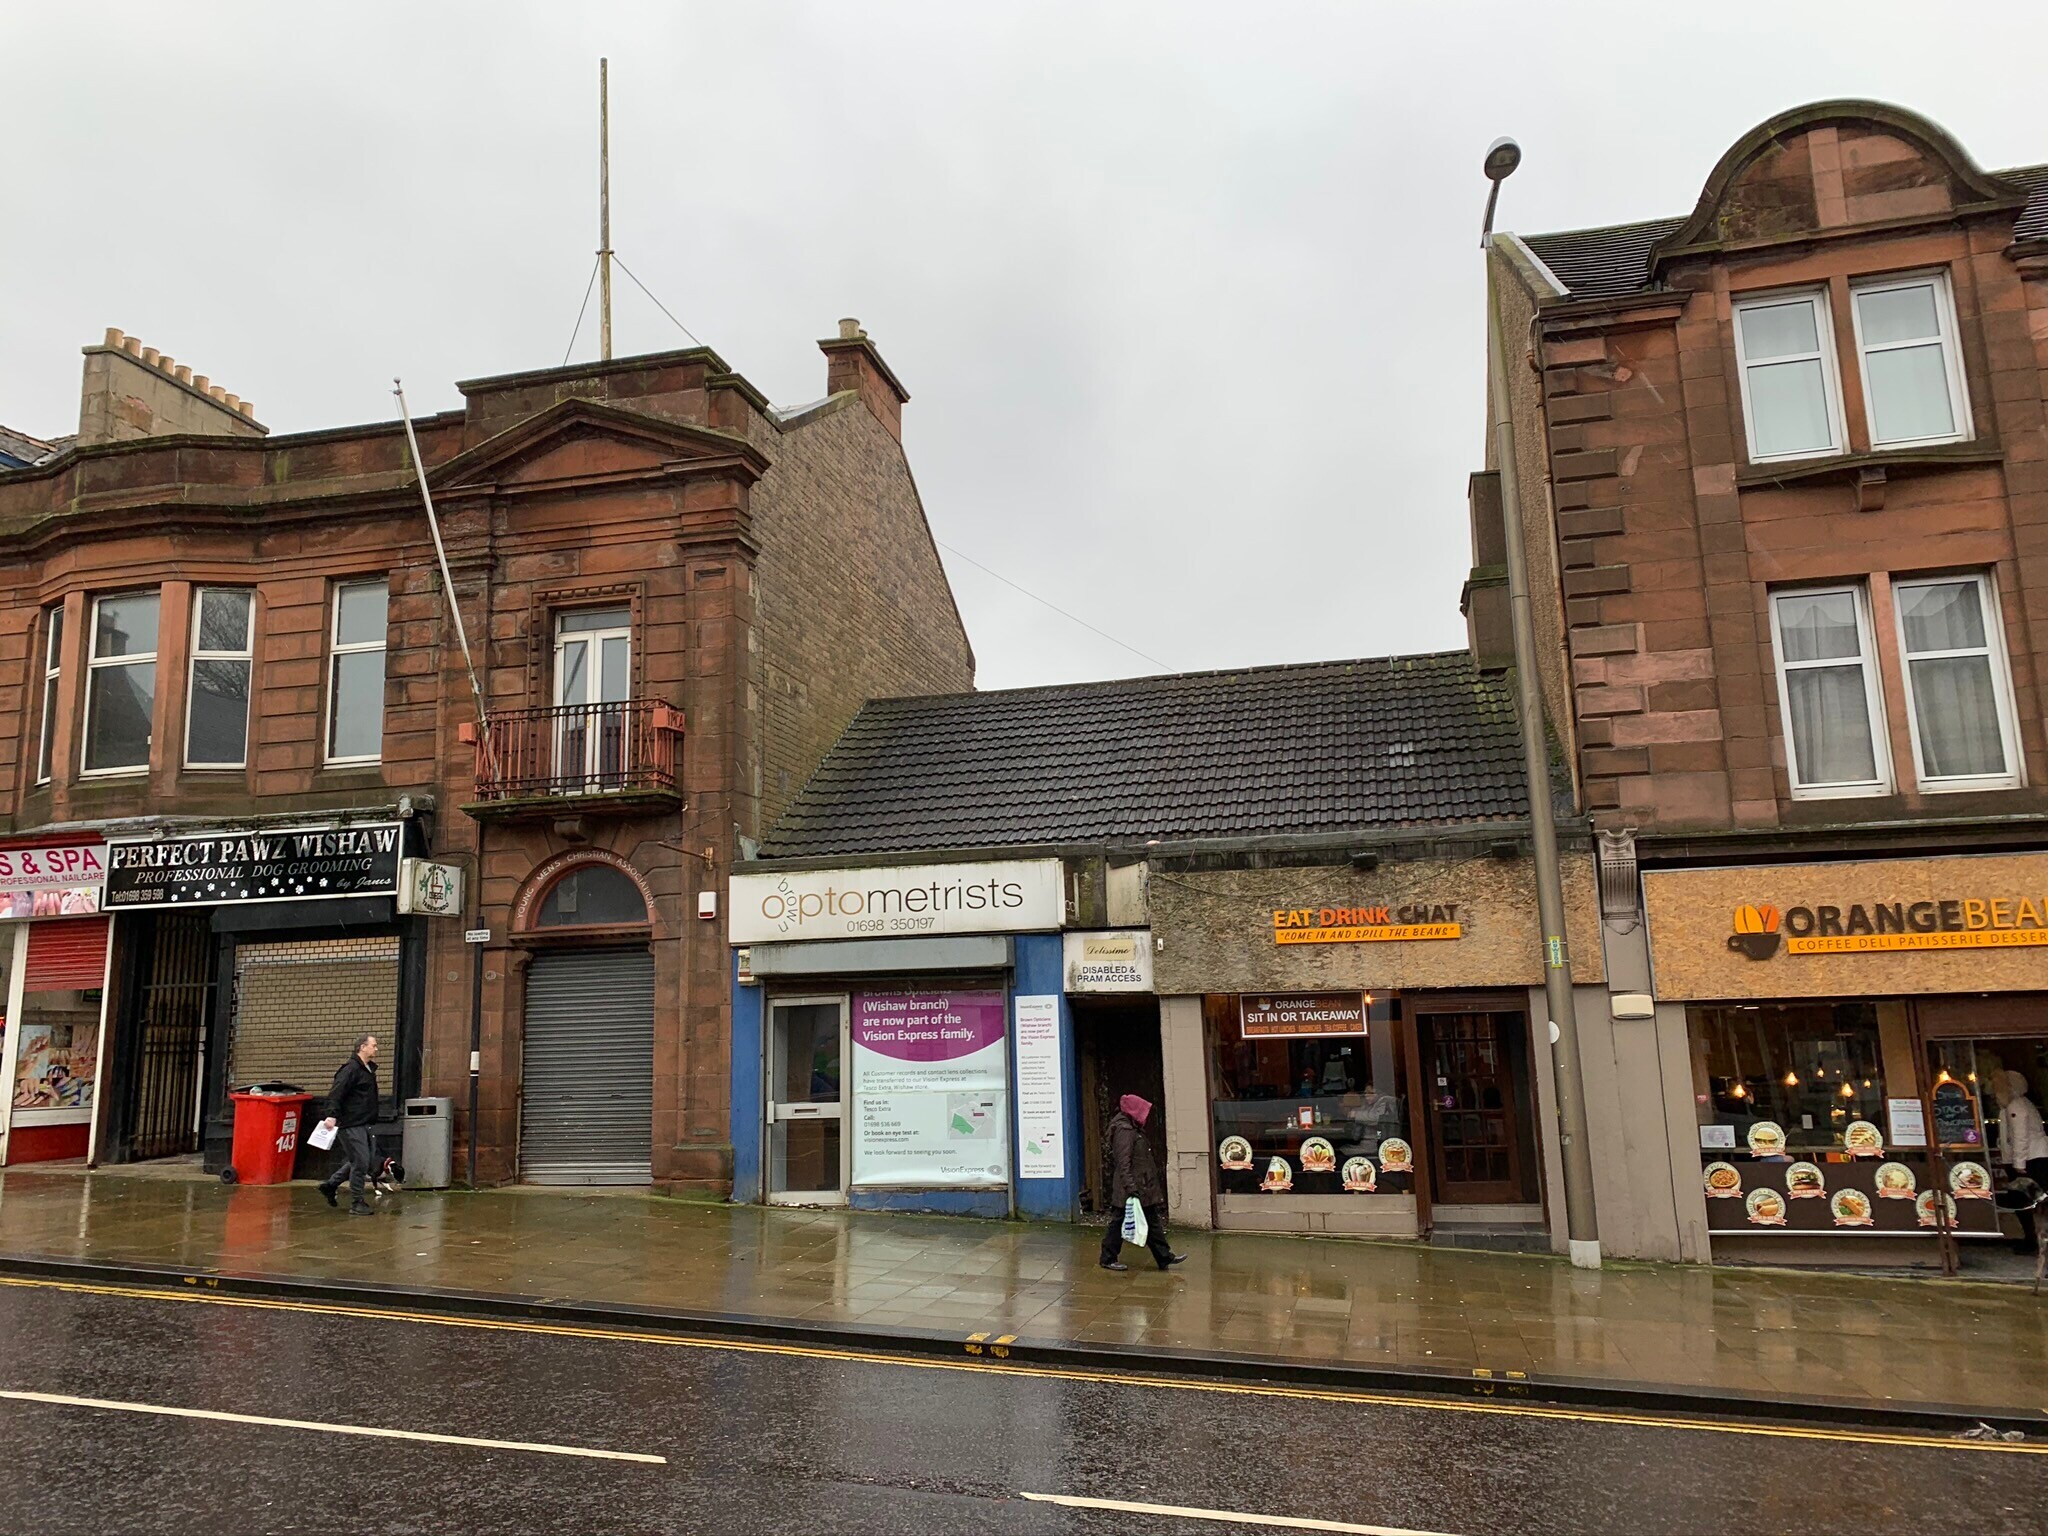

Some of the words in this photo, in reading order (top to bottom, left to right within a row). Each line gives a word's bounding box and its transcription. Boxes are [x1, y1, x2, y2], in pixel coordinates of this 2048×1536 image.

[110, 841, 215, 869] PERFECT
[219, 837, 287, 863] PAWZ
[293, 829, 397, 858] WISHAW
[21, 852, 41, 875] &
[46, 848, 103, 873] SPA
[134, 866, 245, 884] PROFESSIONAL
[250, 863, 284, 877] DOG
[288, 857, 372, 875] GROOMING
[0, 876, 60, 886] ROFESSIONAL
[62, 871, 105, 882] NAILCARE
[517, 887, 534, 919] YOUNG
[566, 851, 612, 862] CHRISTIAN
[616, 858, 655, 909] ASSOCIATION
[762, 878, 1024, 925] optometrists
[777, 877, 799, 933] brown
[846, 919, 885, 932] 01698
[890, 917, 936, 931] 350197
[1273, 909, 1313, 928] EAT
[1319, 906, 1392, 926] DRINK
[1397, 904, 1458, 924] CHAT
[1785, 896, 2048, 938] ORANGEBEA
[1315, 931, 1327, 939] IN
[1331, 930, 1352, 939] AND
[1355, 928, 1384, 938] SPILL
[1388, 928, 1408, 937] THE
[1797, 939, 1852, 950] COFFEE
[1859, 938, 1891, 948] DELI
[1899, 935, 1982, 946] PATISSERIE
[1990, 932, 2048, 944] DESSER
[1077, 974, 1103, 982] PRAM
[1104, 974, 1142, 982] ACCESS
[1082, 966, 1127, 974] DISABLED
[1129, 965, 1136, 973] &
[863, 1000, 907, 1013] (Wishaw
[909, 998, 949, 1011] branch)
[863, 1018, 880, 1026] are
[882, 1017, 904, 1026] now
[907, 1015, 928, 1028] part
[931, 1014, 943, 1025] of
[943, 1013, 962, 1024] the
[1247, 1013, 1265, 1023] SIT
[1267, 1012, 1278, 1022] IN
[1280, 1012, 1298, 1022] OR
[1299, 1010, 1360, 1021] TAKEAWAY
[862, 1030, 895, 1041] Vision
[898, 1029, 938, 1043] Express
[940, 1028, 975, 1042] family.
[276, 1134, 295, 1153] 143
